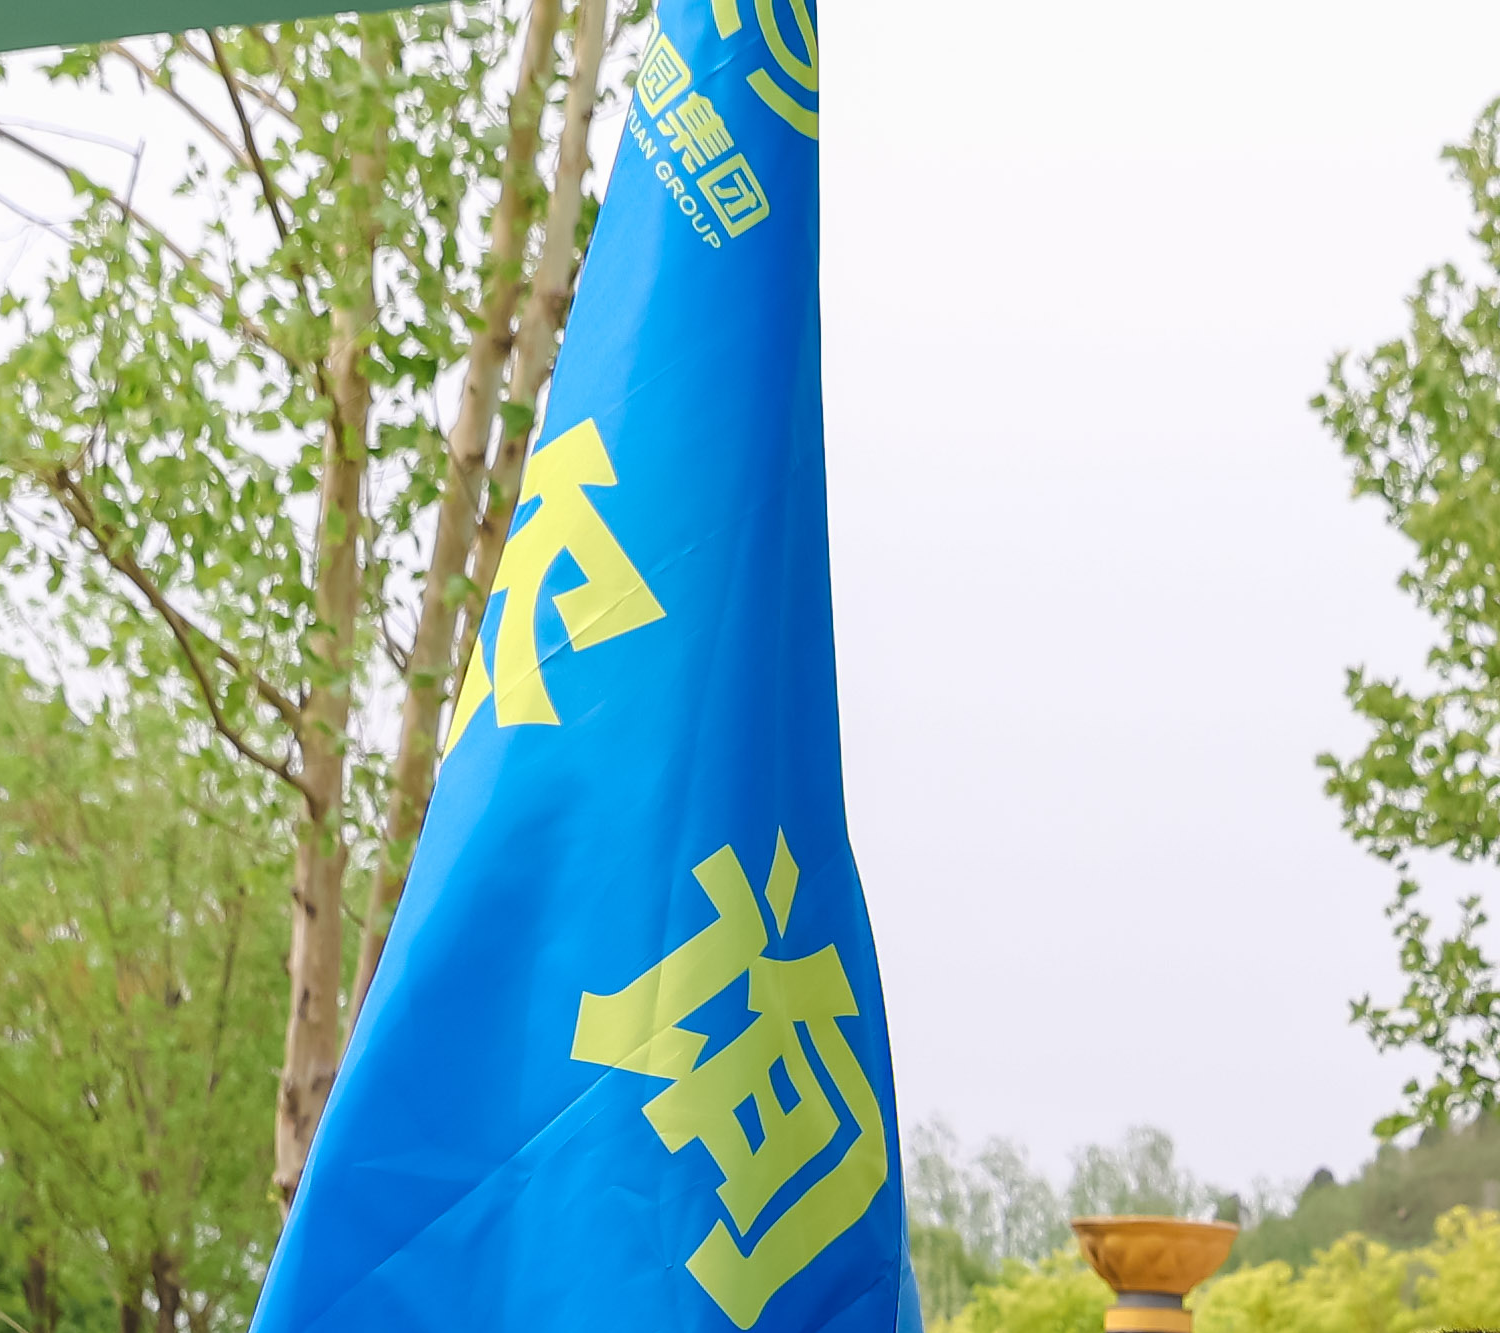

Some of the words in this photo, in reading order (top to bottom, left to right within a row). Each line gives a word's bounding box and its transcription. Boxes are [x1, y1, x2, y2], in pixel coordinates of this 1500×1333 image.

[636, 10, 770, 238] 圆集团
[655, 160, 721, 248] GROUP
